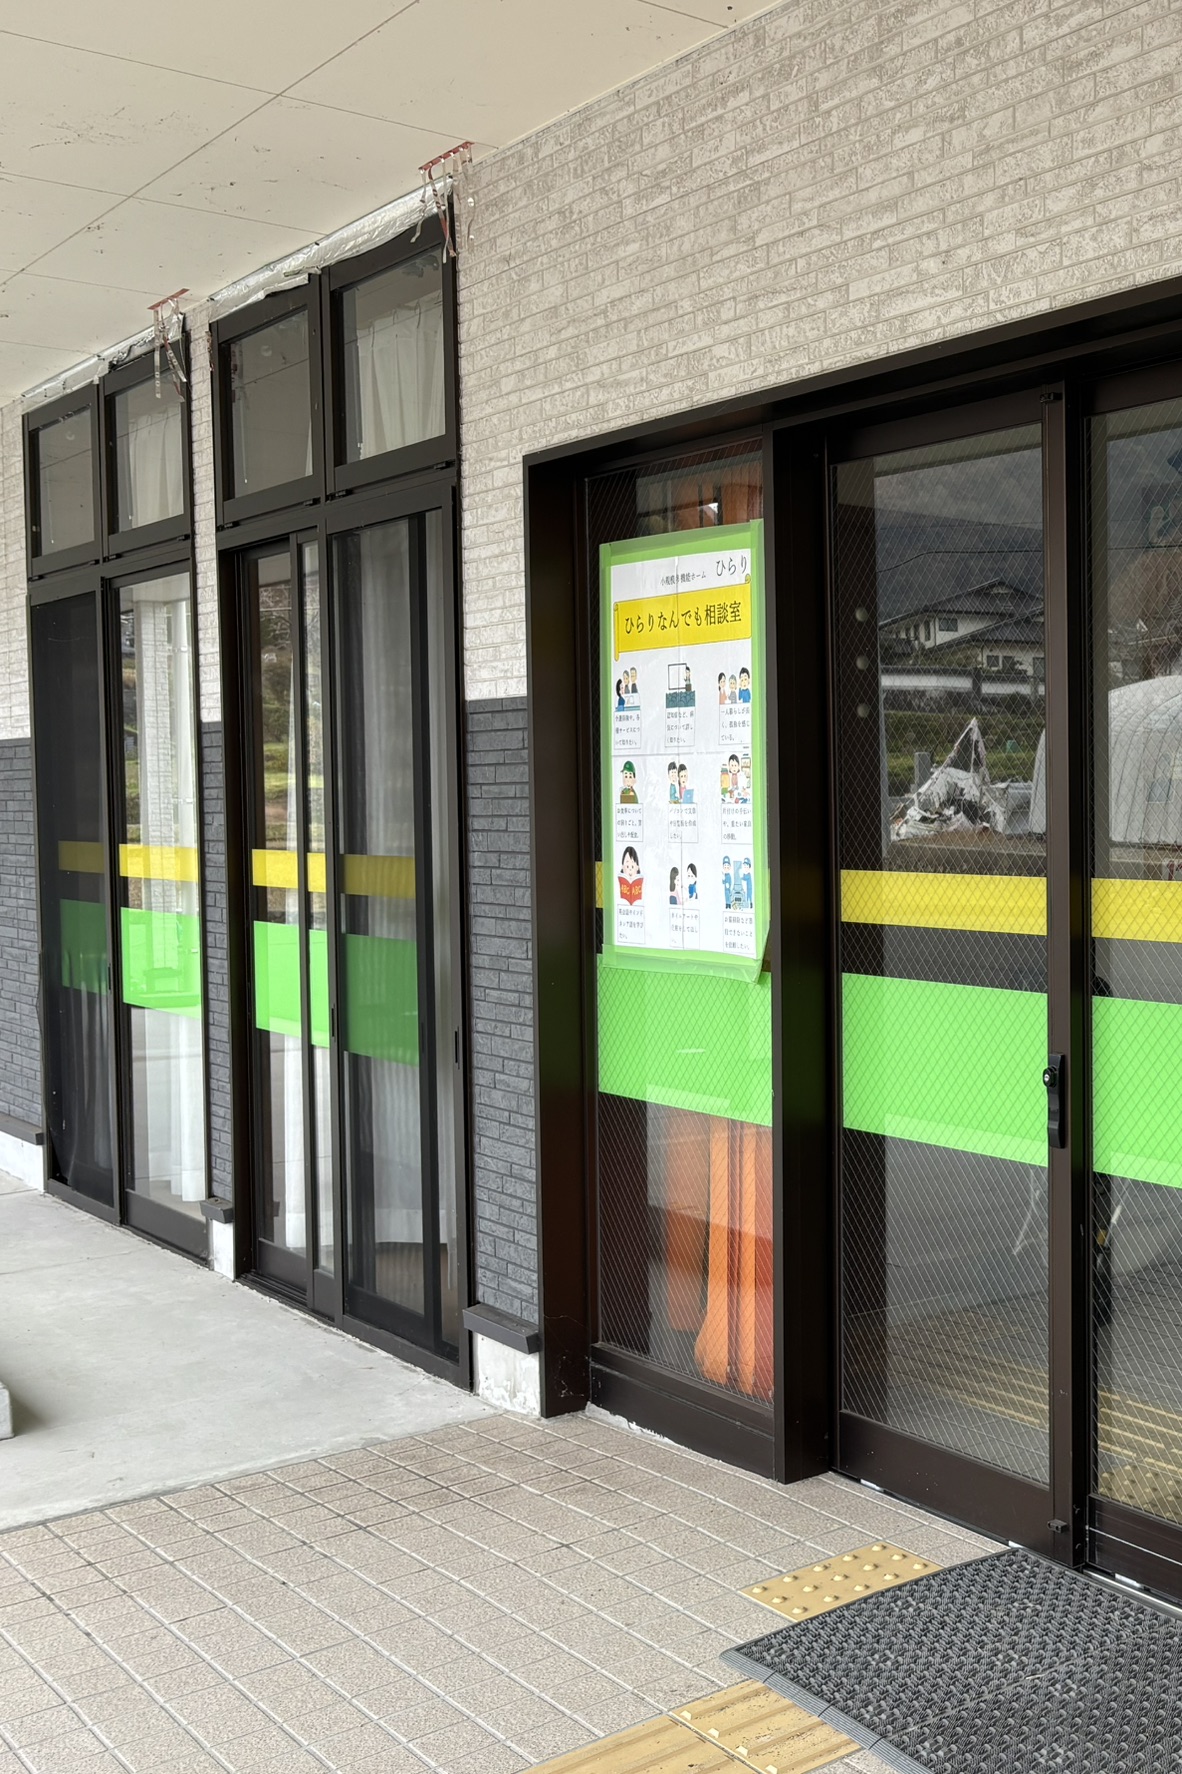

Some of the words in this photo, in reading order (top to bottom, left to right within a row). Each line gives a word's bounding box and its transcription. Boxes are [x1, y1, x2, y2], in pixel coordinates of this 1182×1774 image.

[715, 554, 748, 577] ひらり
[624, 600, 742, 635] ひらりなんでも相談室
